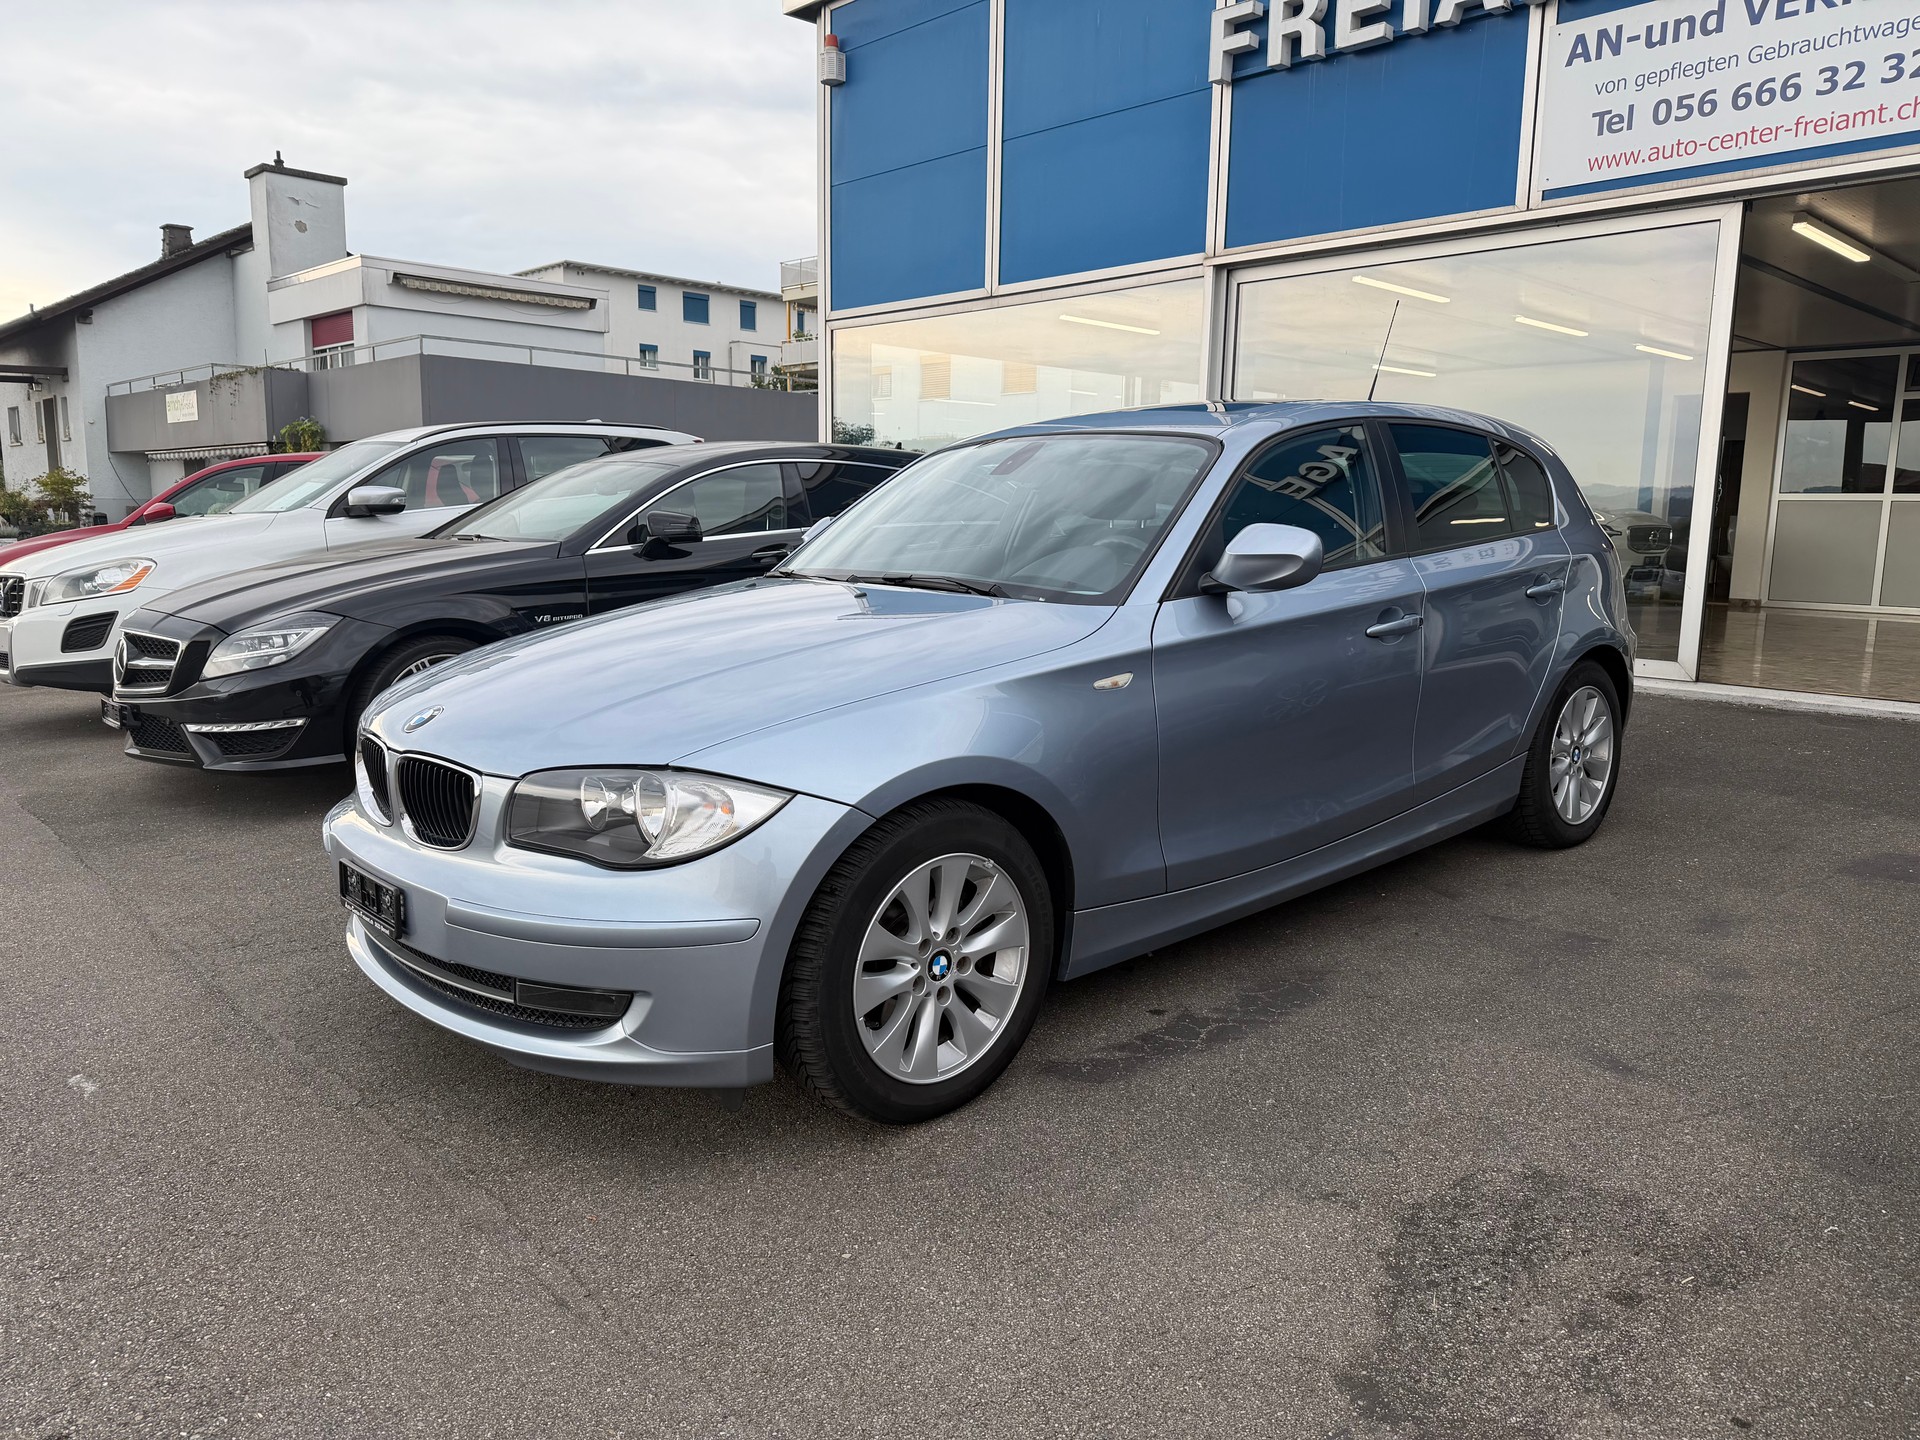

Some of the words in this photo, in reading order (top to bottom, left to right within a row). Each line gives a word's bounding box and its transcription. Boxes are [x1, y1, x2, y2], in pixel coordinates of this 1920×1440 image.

[1565, 0, 1726, 67] AN-und
[1743, 0, 1852, 26] VE
[1594, 77, 1628, 95] von
[1635, 54, 1740, 92] gepflegten
[1748, 15, 1920, 64] Gebrauchtwage
[1588, 96, 1920, 171] www.auto-center-freiamt.ch
[1592, 104, 1635, 136] Tel
[1652, 89, 1718, 126] 056
[1731, 72, 1802, 111] 666
[1815, 60, 1866, 96] 32
